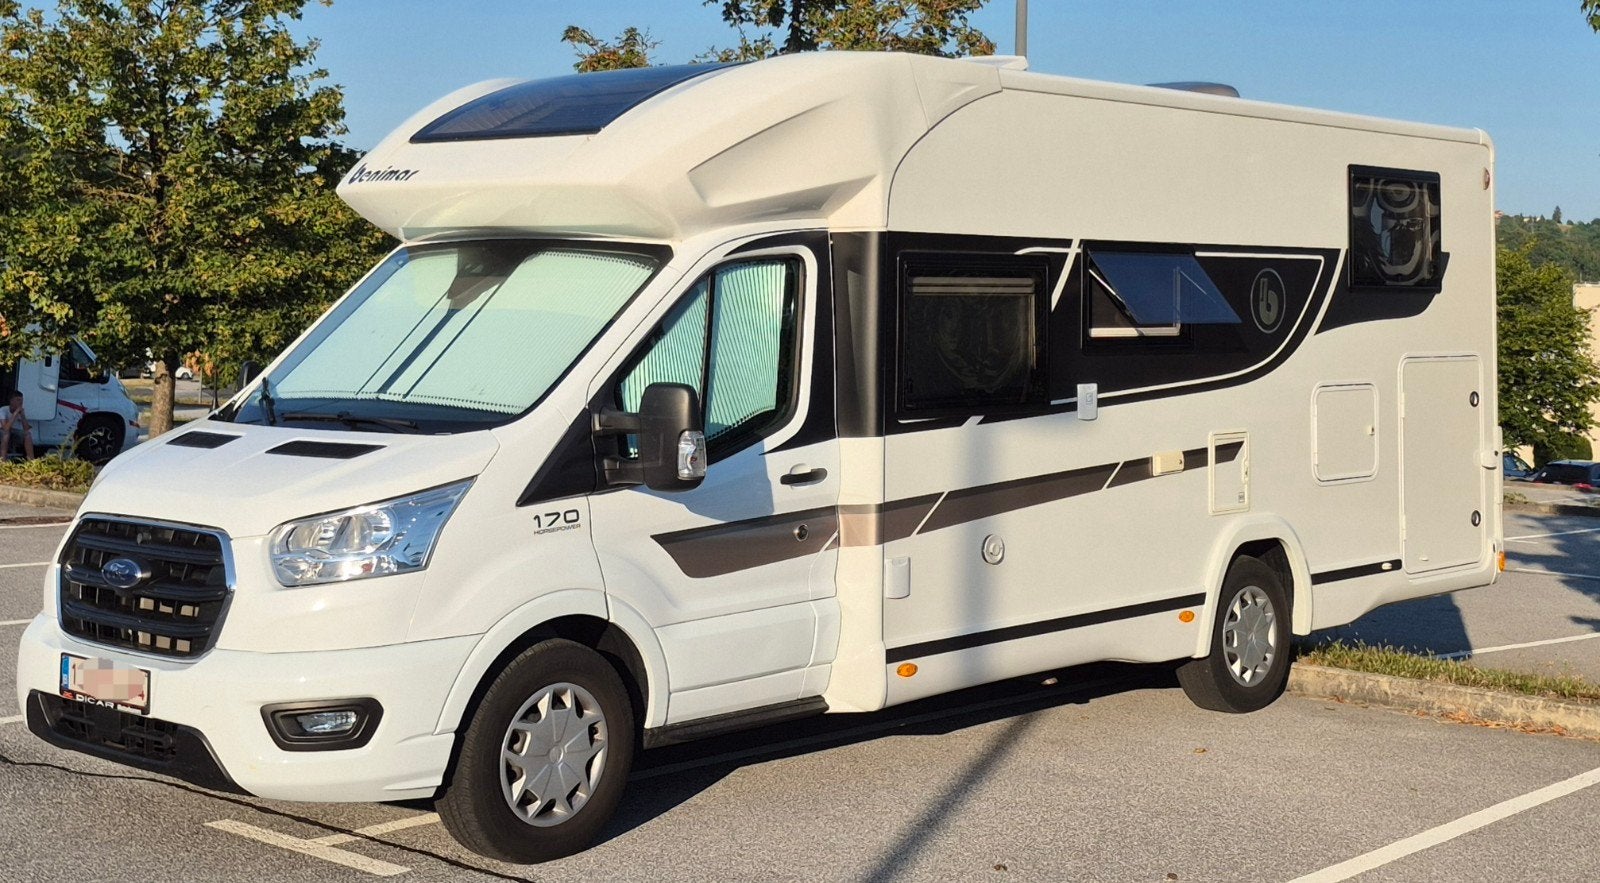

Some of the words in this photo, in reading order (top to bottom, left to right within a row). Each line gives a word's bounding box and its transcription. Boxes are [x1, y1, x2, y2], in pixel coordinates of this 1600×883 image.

[348, 162, 420, 184] benimar
[533, 509, 580, 529] 170
[533, 523, 581, 536] HORSEPOWER
